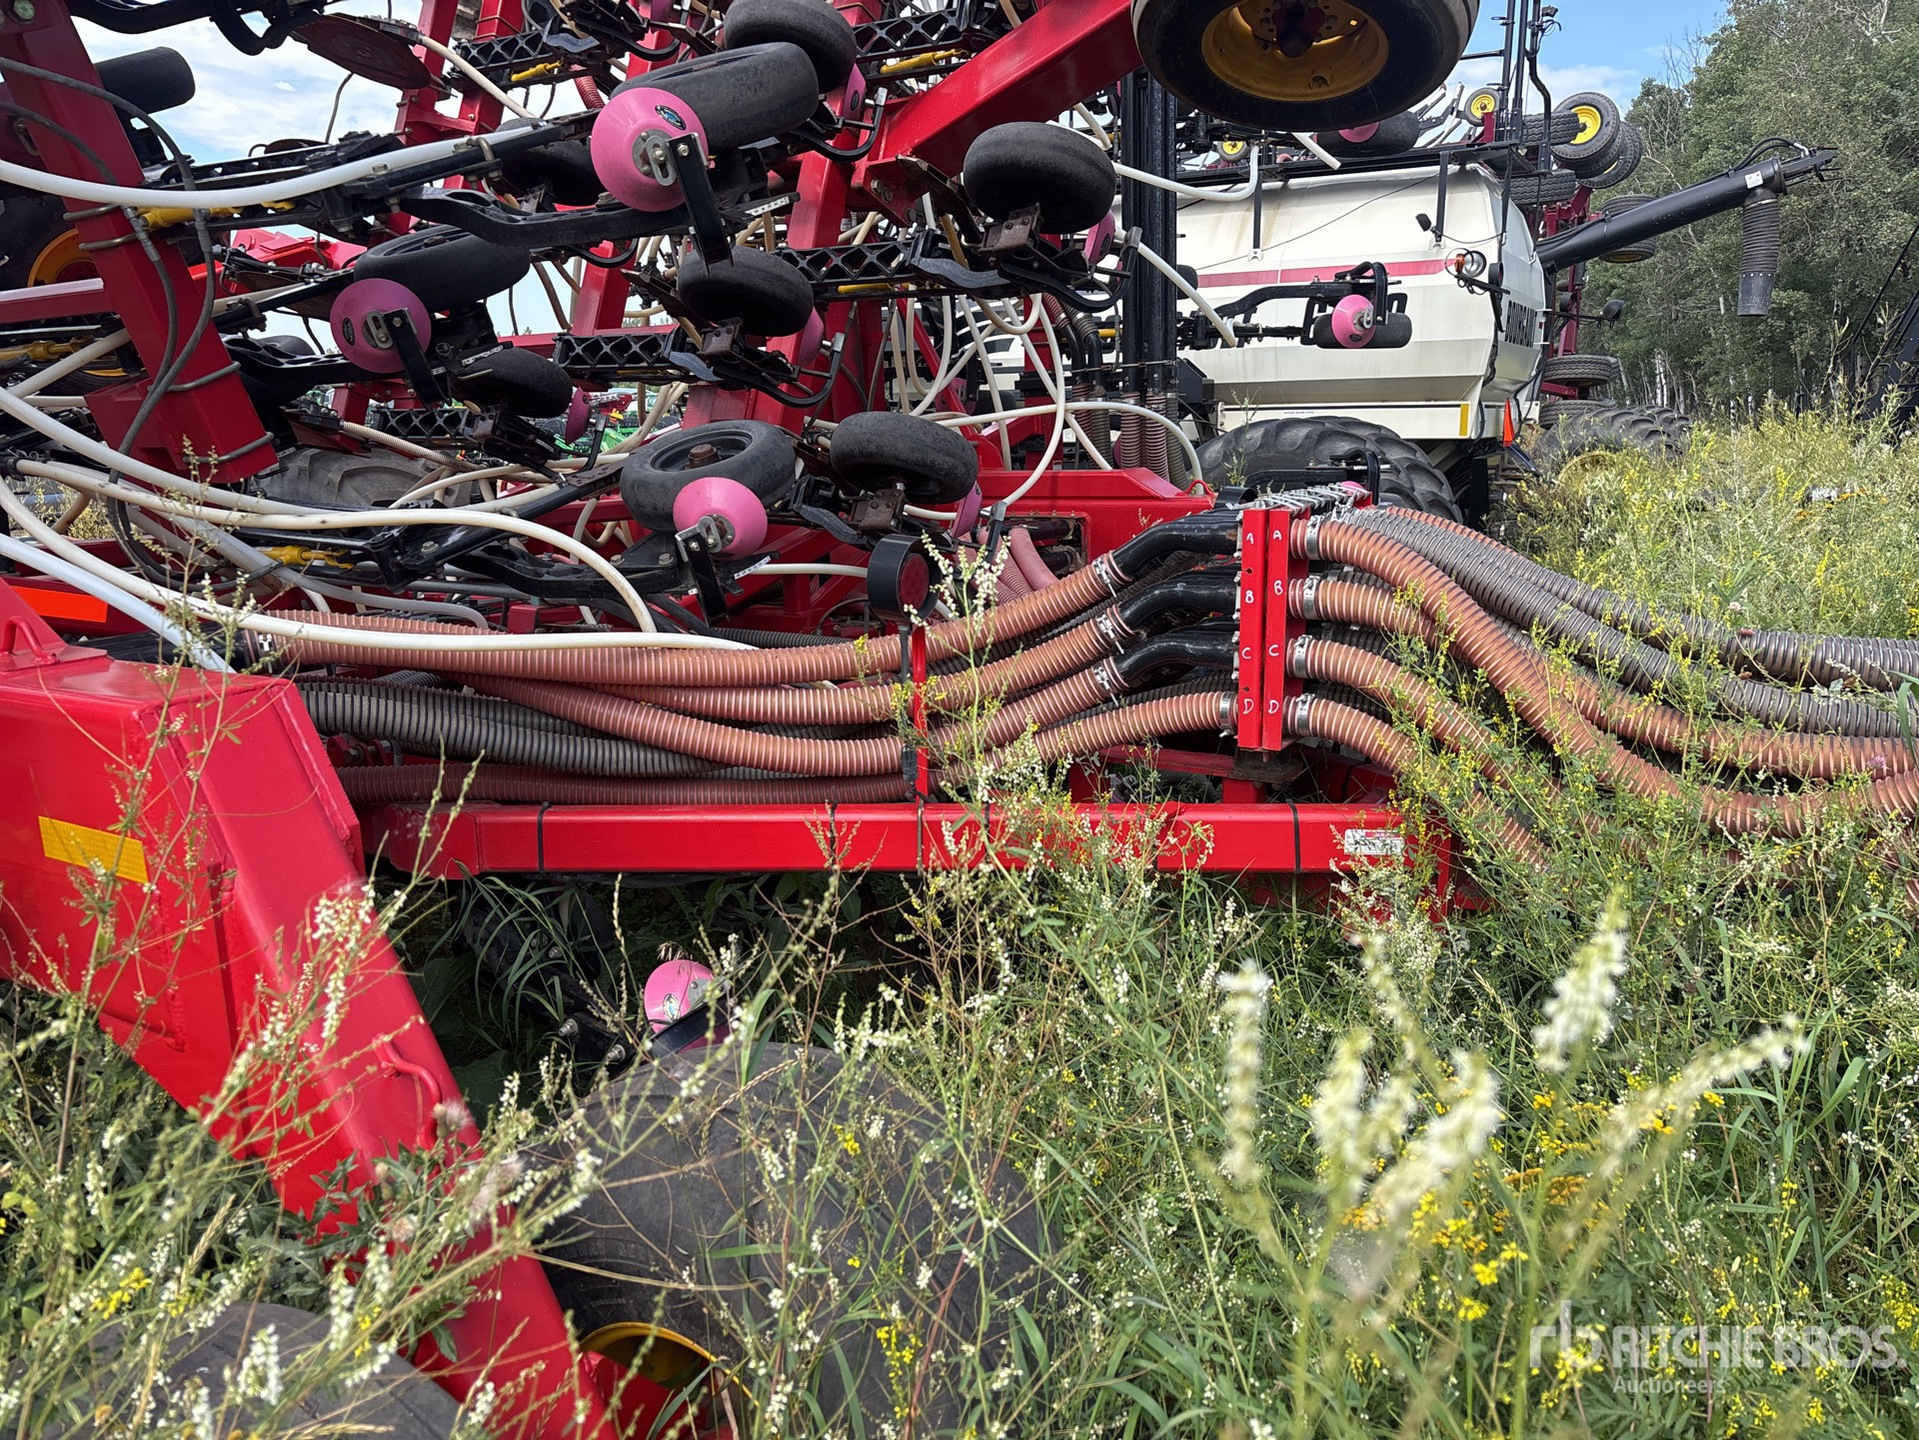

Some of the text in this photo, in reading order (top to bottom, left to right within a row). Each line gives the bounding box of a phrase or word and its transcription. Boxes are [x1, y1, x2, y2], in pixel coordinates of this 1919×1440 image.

[1245, 532, 1254, 545] A
[1272, 529, 1282, 541] A
[1273, 580, 1283, 595] B
[1245, 590, 1254, 603] B
[1241, 647, 1251, 659] C
[1268, 644, 1279, 657] C
[1243, 699, 1254, 714] D
[1268, 699, 1279, 714] D
